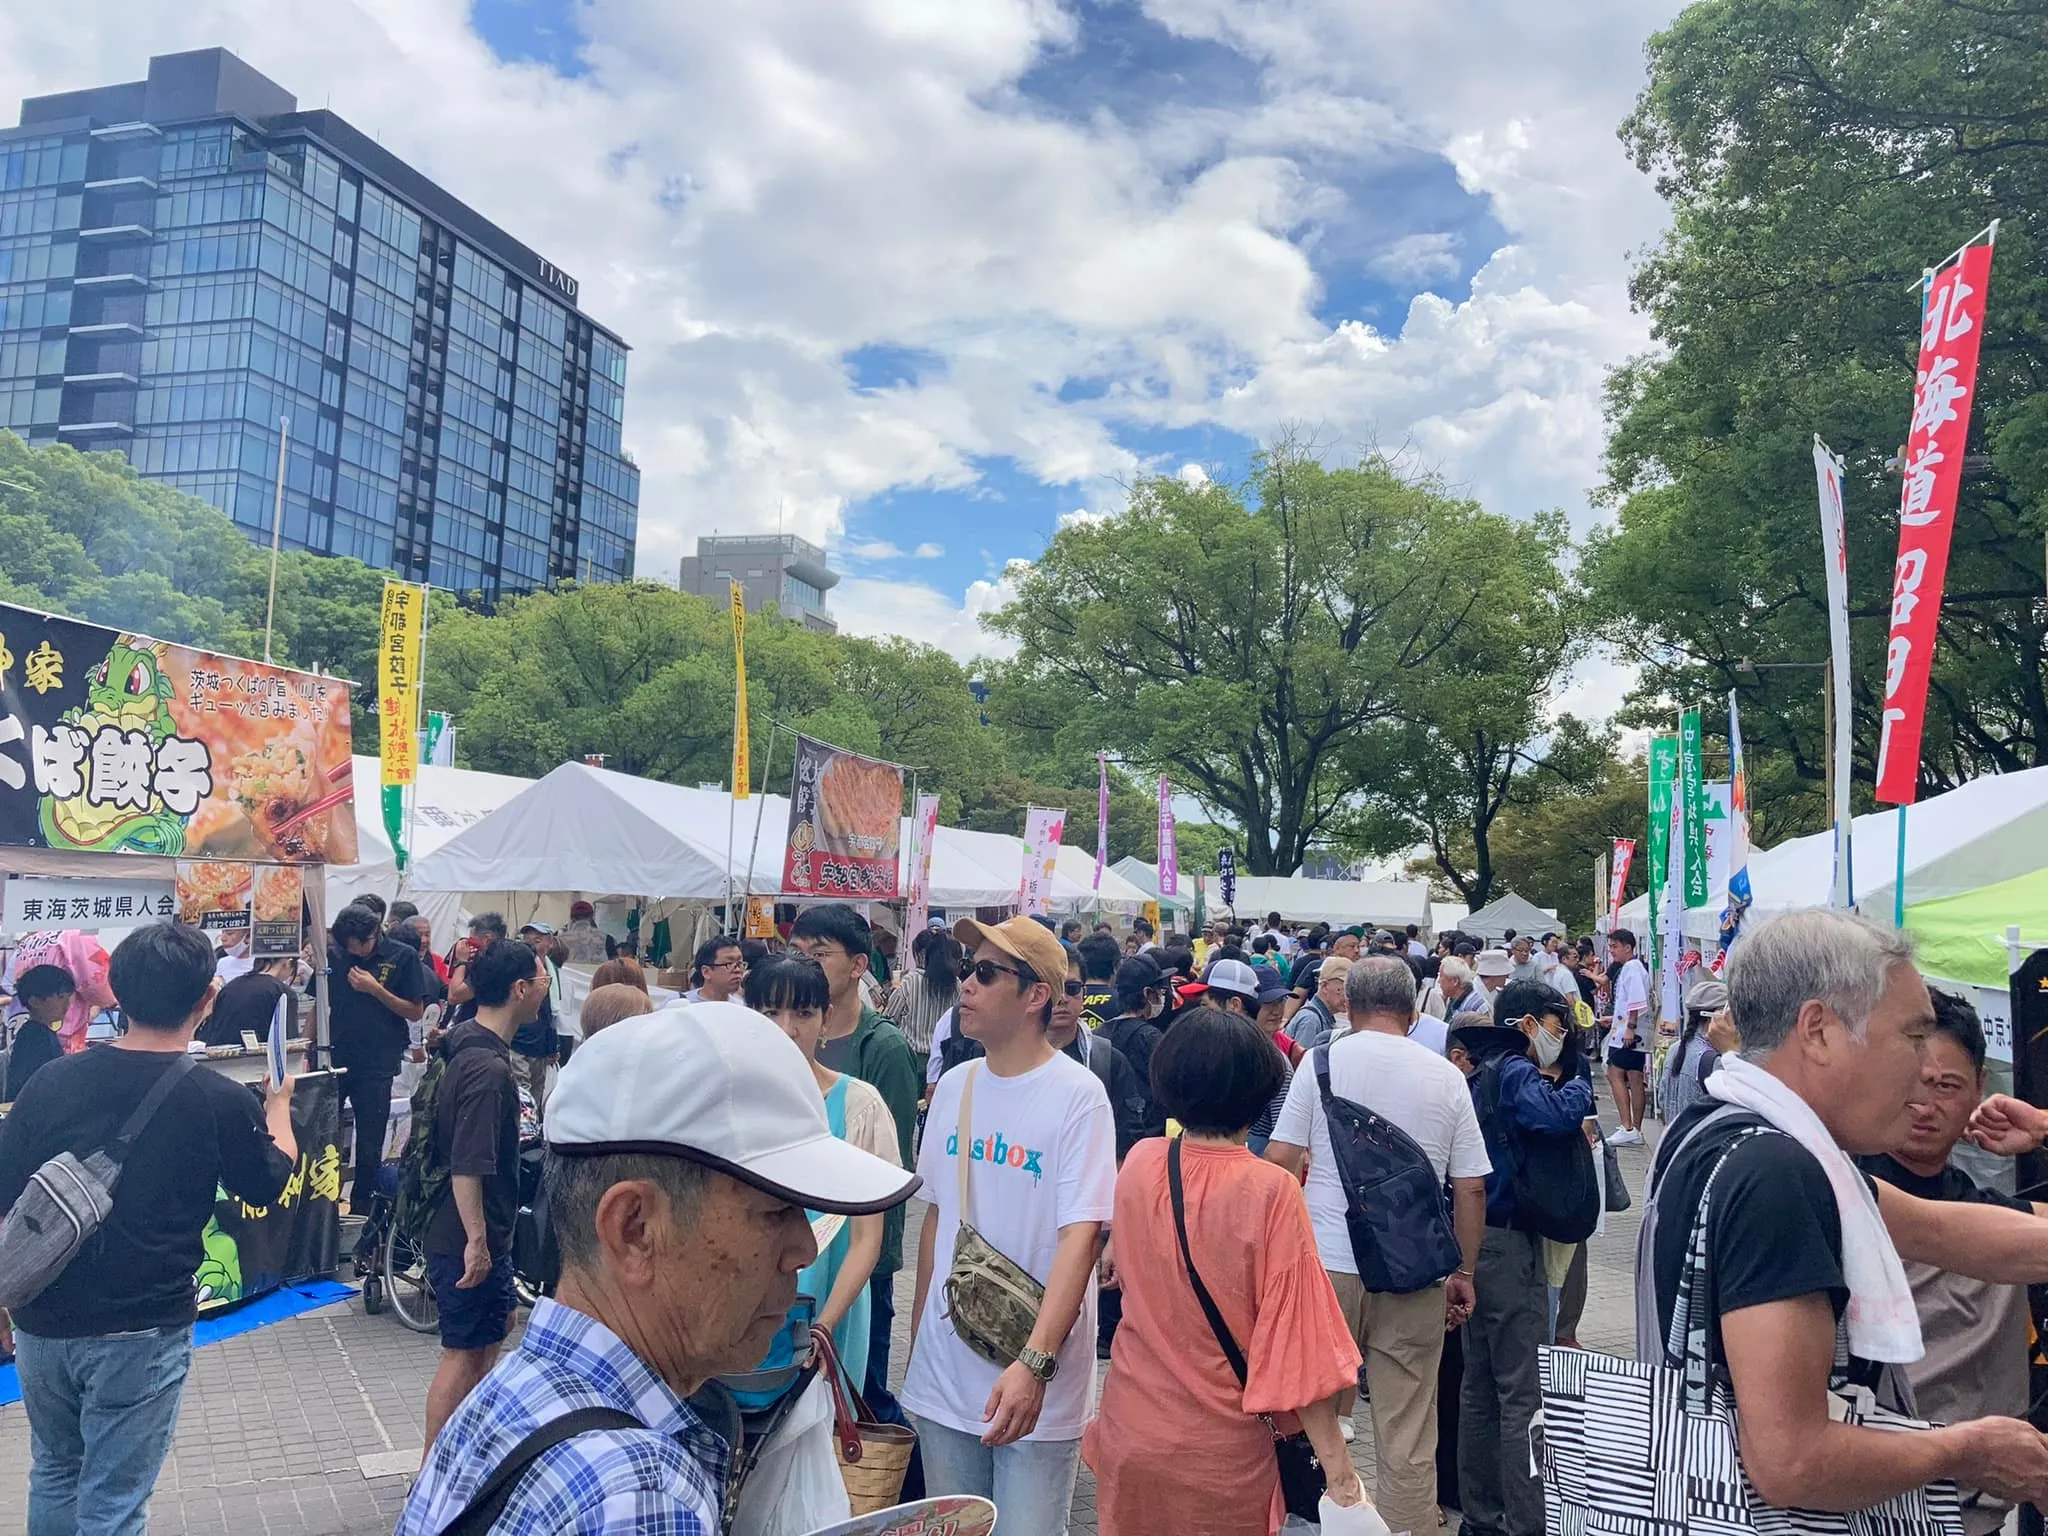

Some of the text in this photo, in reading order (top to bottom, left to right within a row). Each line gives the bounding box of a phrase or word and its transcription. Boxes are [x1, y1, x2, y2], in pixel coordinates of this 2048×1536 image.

[537, 257, 576, 296] TIAD
[22, 894, 174, 922] 東海茨城県人会
[1083, 994, 1112, 1005] AFF
[946, 1126, 1043, 1181] dstbox
[1686, 1329, 1706, 1414] IKEA
